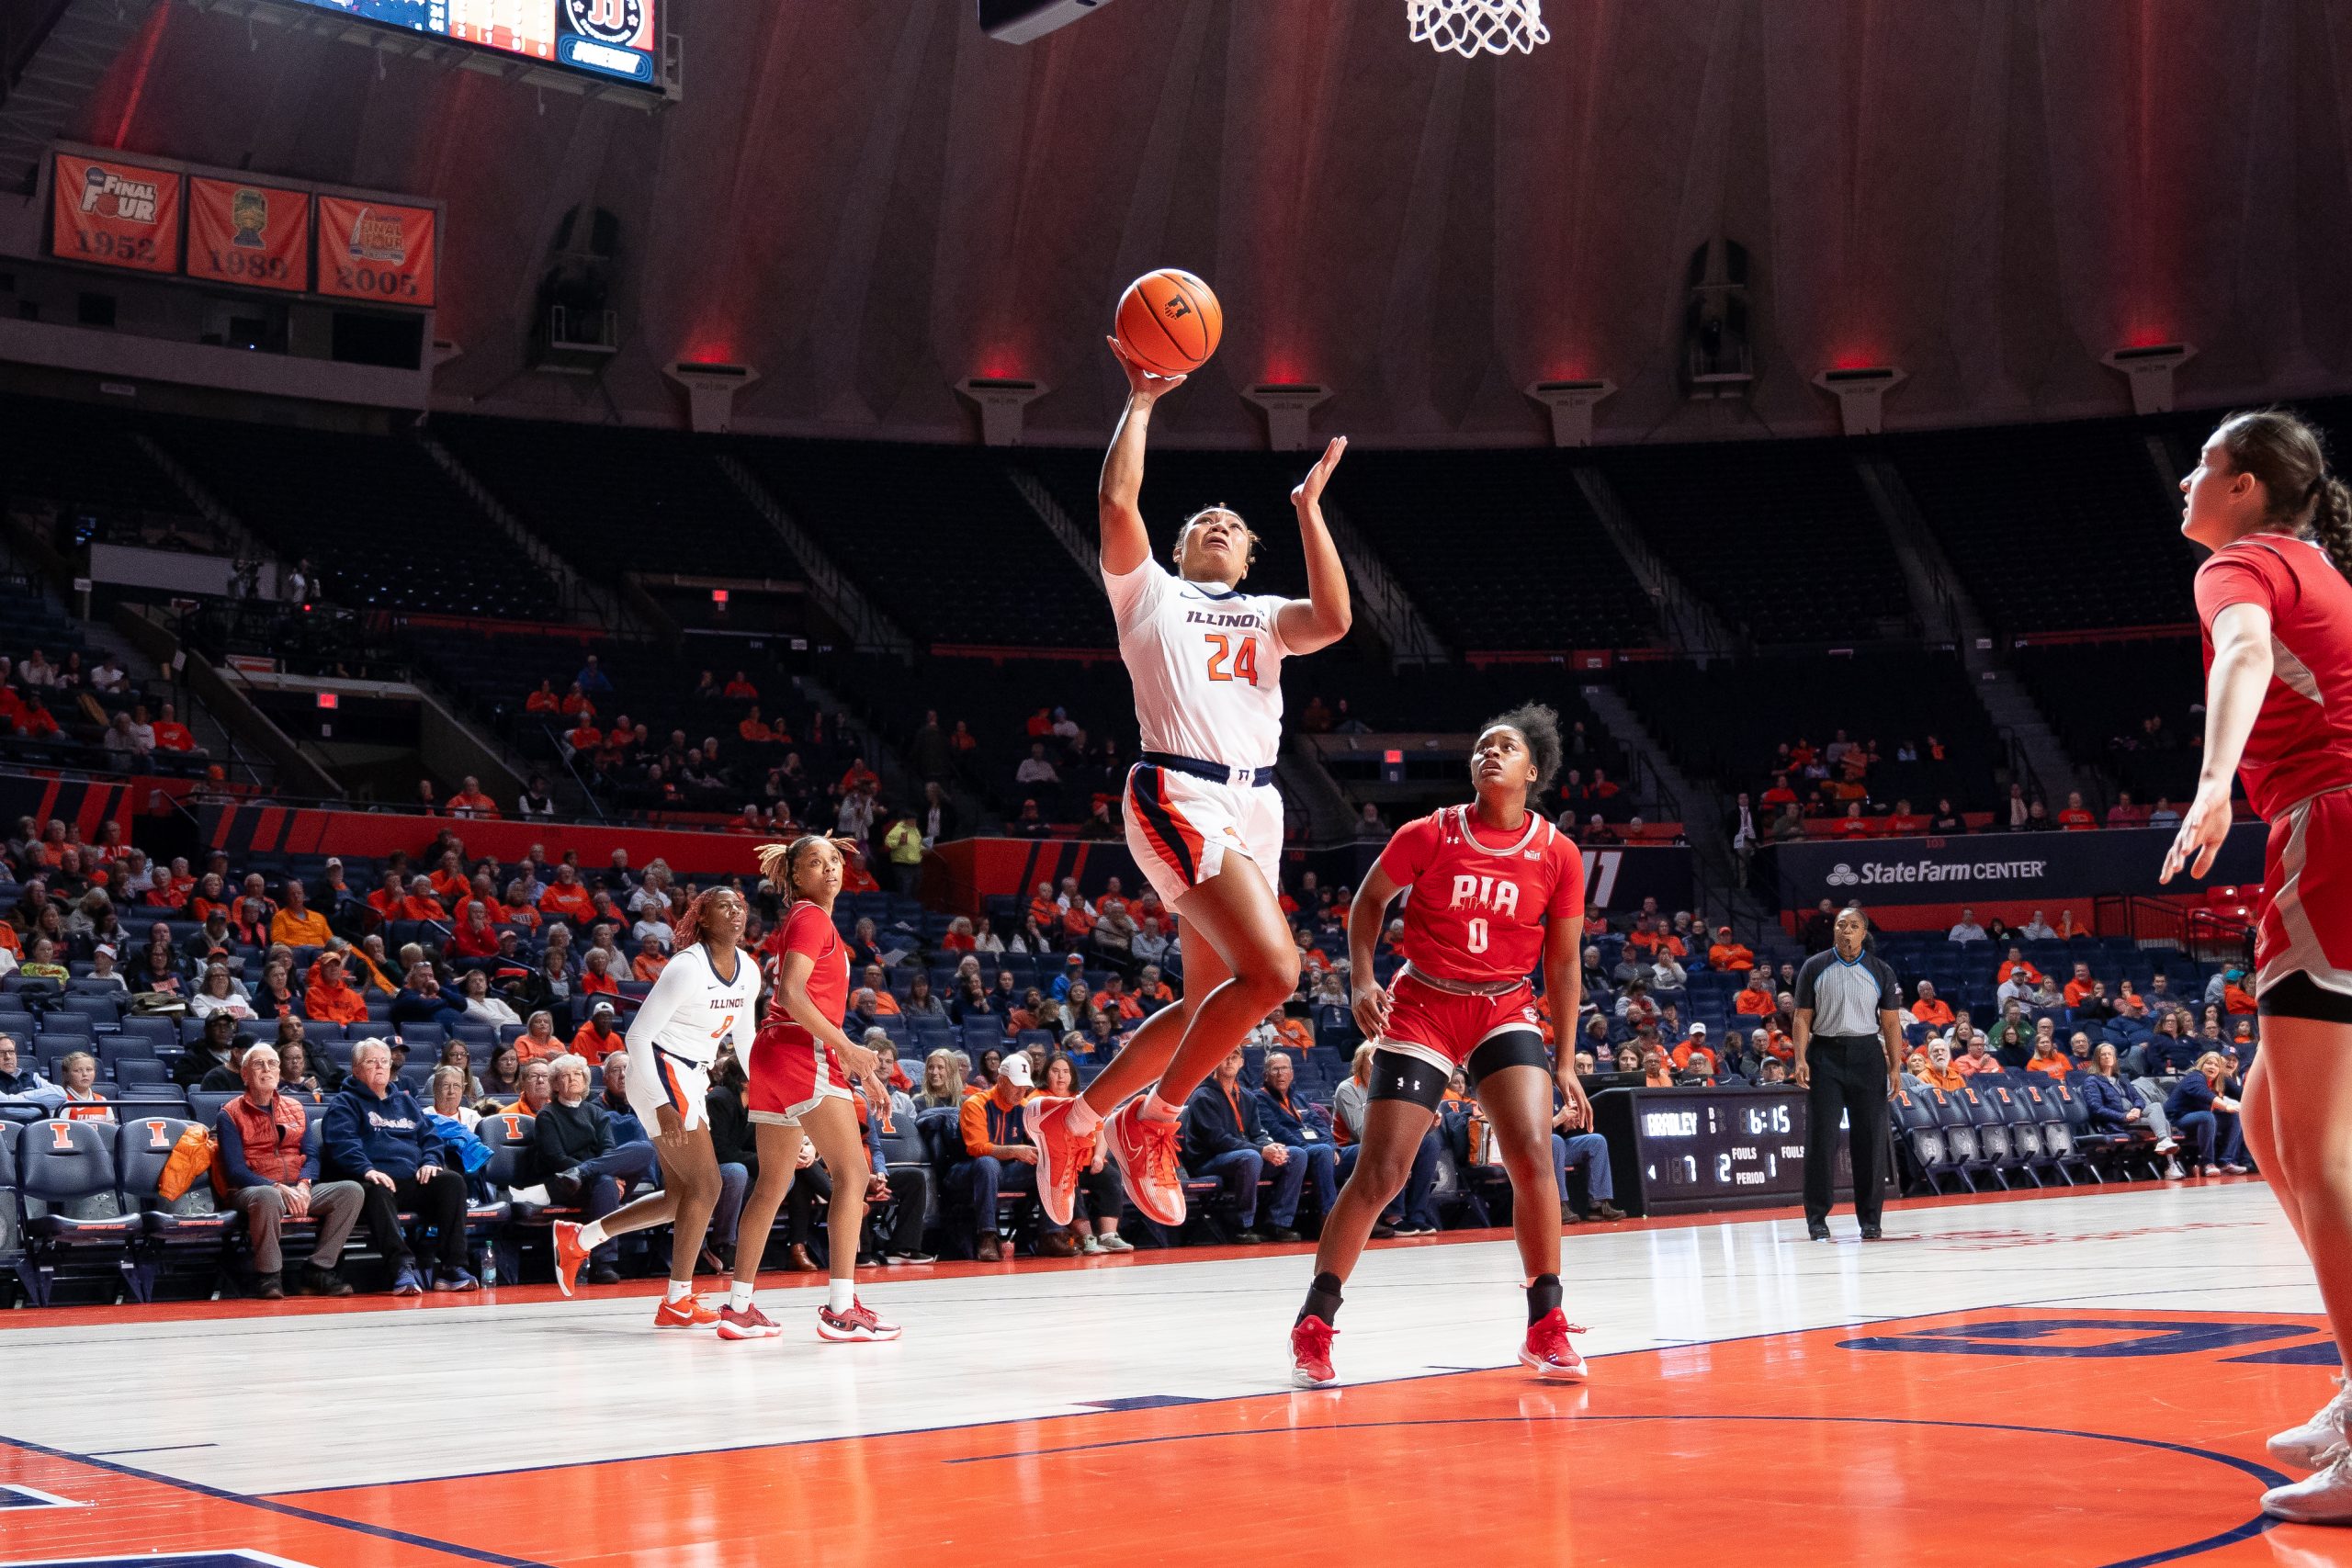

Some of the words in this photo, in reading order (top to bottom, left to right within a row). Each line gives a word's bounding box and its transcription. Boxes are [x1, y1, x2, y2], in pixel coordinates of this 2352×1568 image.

[103, 174, 155, 201] FINAL
[75, 230, 156, 264] 1952
[336, 265, 418, 297] 2005
[1186, 611, 1267, 632] ILLINOI
[1204, 634, 1258, 686] 24
[1449, 874, 1520, 919] PIA
[1467, 918, 1488, 953] 0
[711, 1015, 734, 1038] 8
[503, 1116, 524, 1139] I
[1647, 1112, 1697, 1135] BRADLEY
[1749, 1105, 1791, 1134] 6:15
[50, 1122, 74, 1148] I
[147, 1121, 170, 1146] I
[1732, 1147, 1758, 1159] FOULS
[1770, 1153, 1777, 1177] 1
[1719, 1154, 1731, 1182] 2
[1736, 1172, 1765, 1184] PERIOD
